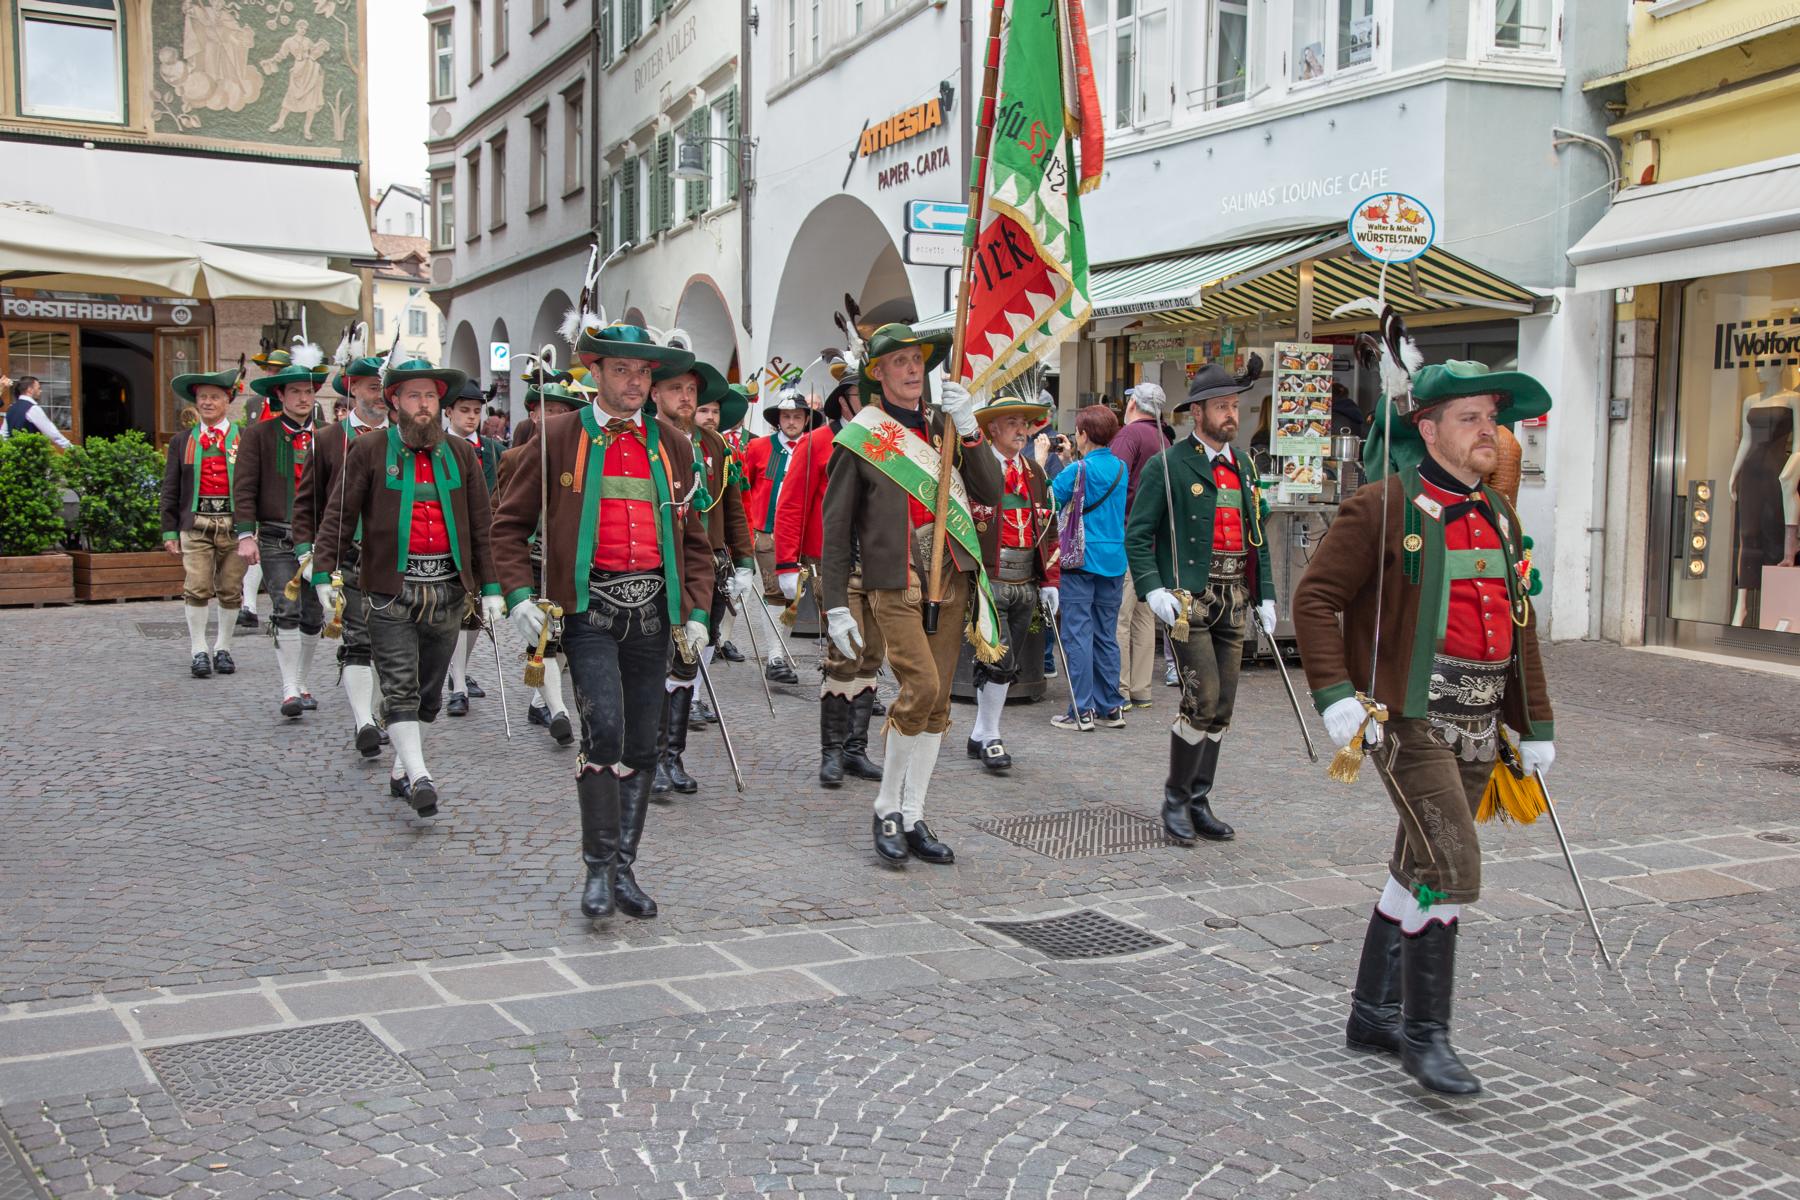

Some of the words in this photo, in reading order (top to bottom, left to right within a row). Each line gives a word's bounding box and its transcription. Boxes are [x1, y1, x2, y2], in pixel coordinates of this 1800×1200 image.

[634, 47, 663, 94] ROTER
[665, 15, 696, 65] ADLER
[860, 98, 941, 158] ATHESIA
[878, 161, 909, 191] PAPIER
[917, 145, 950, 176] CARTA
[1221, 188, 1275, 214] SALINAS
[1282, 176, 1343, 203] LOUNGE
[1348, 167, 1389, 192] CAFE
[1357, 230, 1427, 245] WÜRSTELSTAND
[1367, 223, 1388, 231] Walter
[3, 299, 152, 322] FORSTERBRÄU
[1159, 299, 1173, 308] HOT
